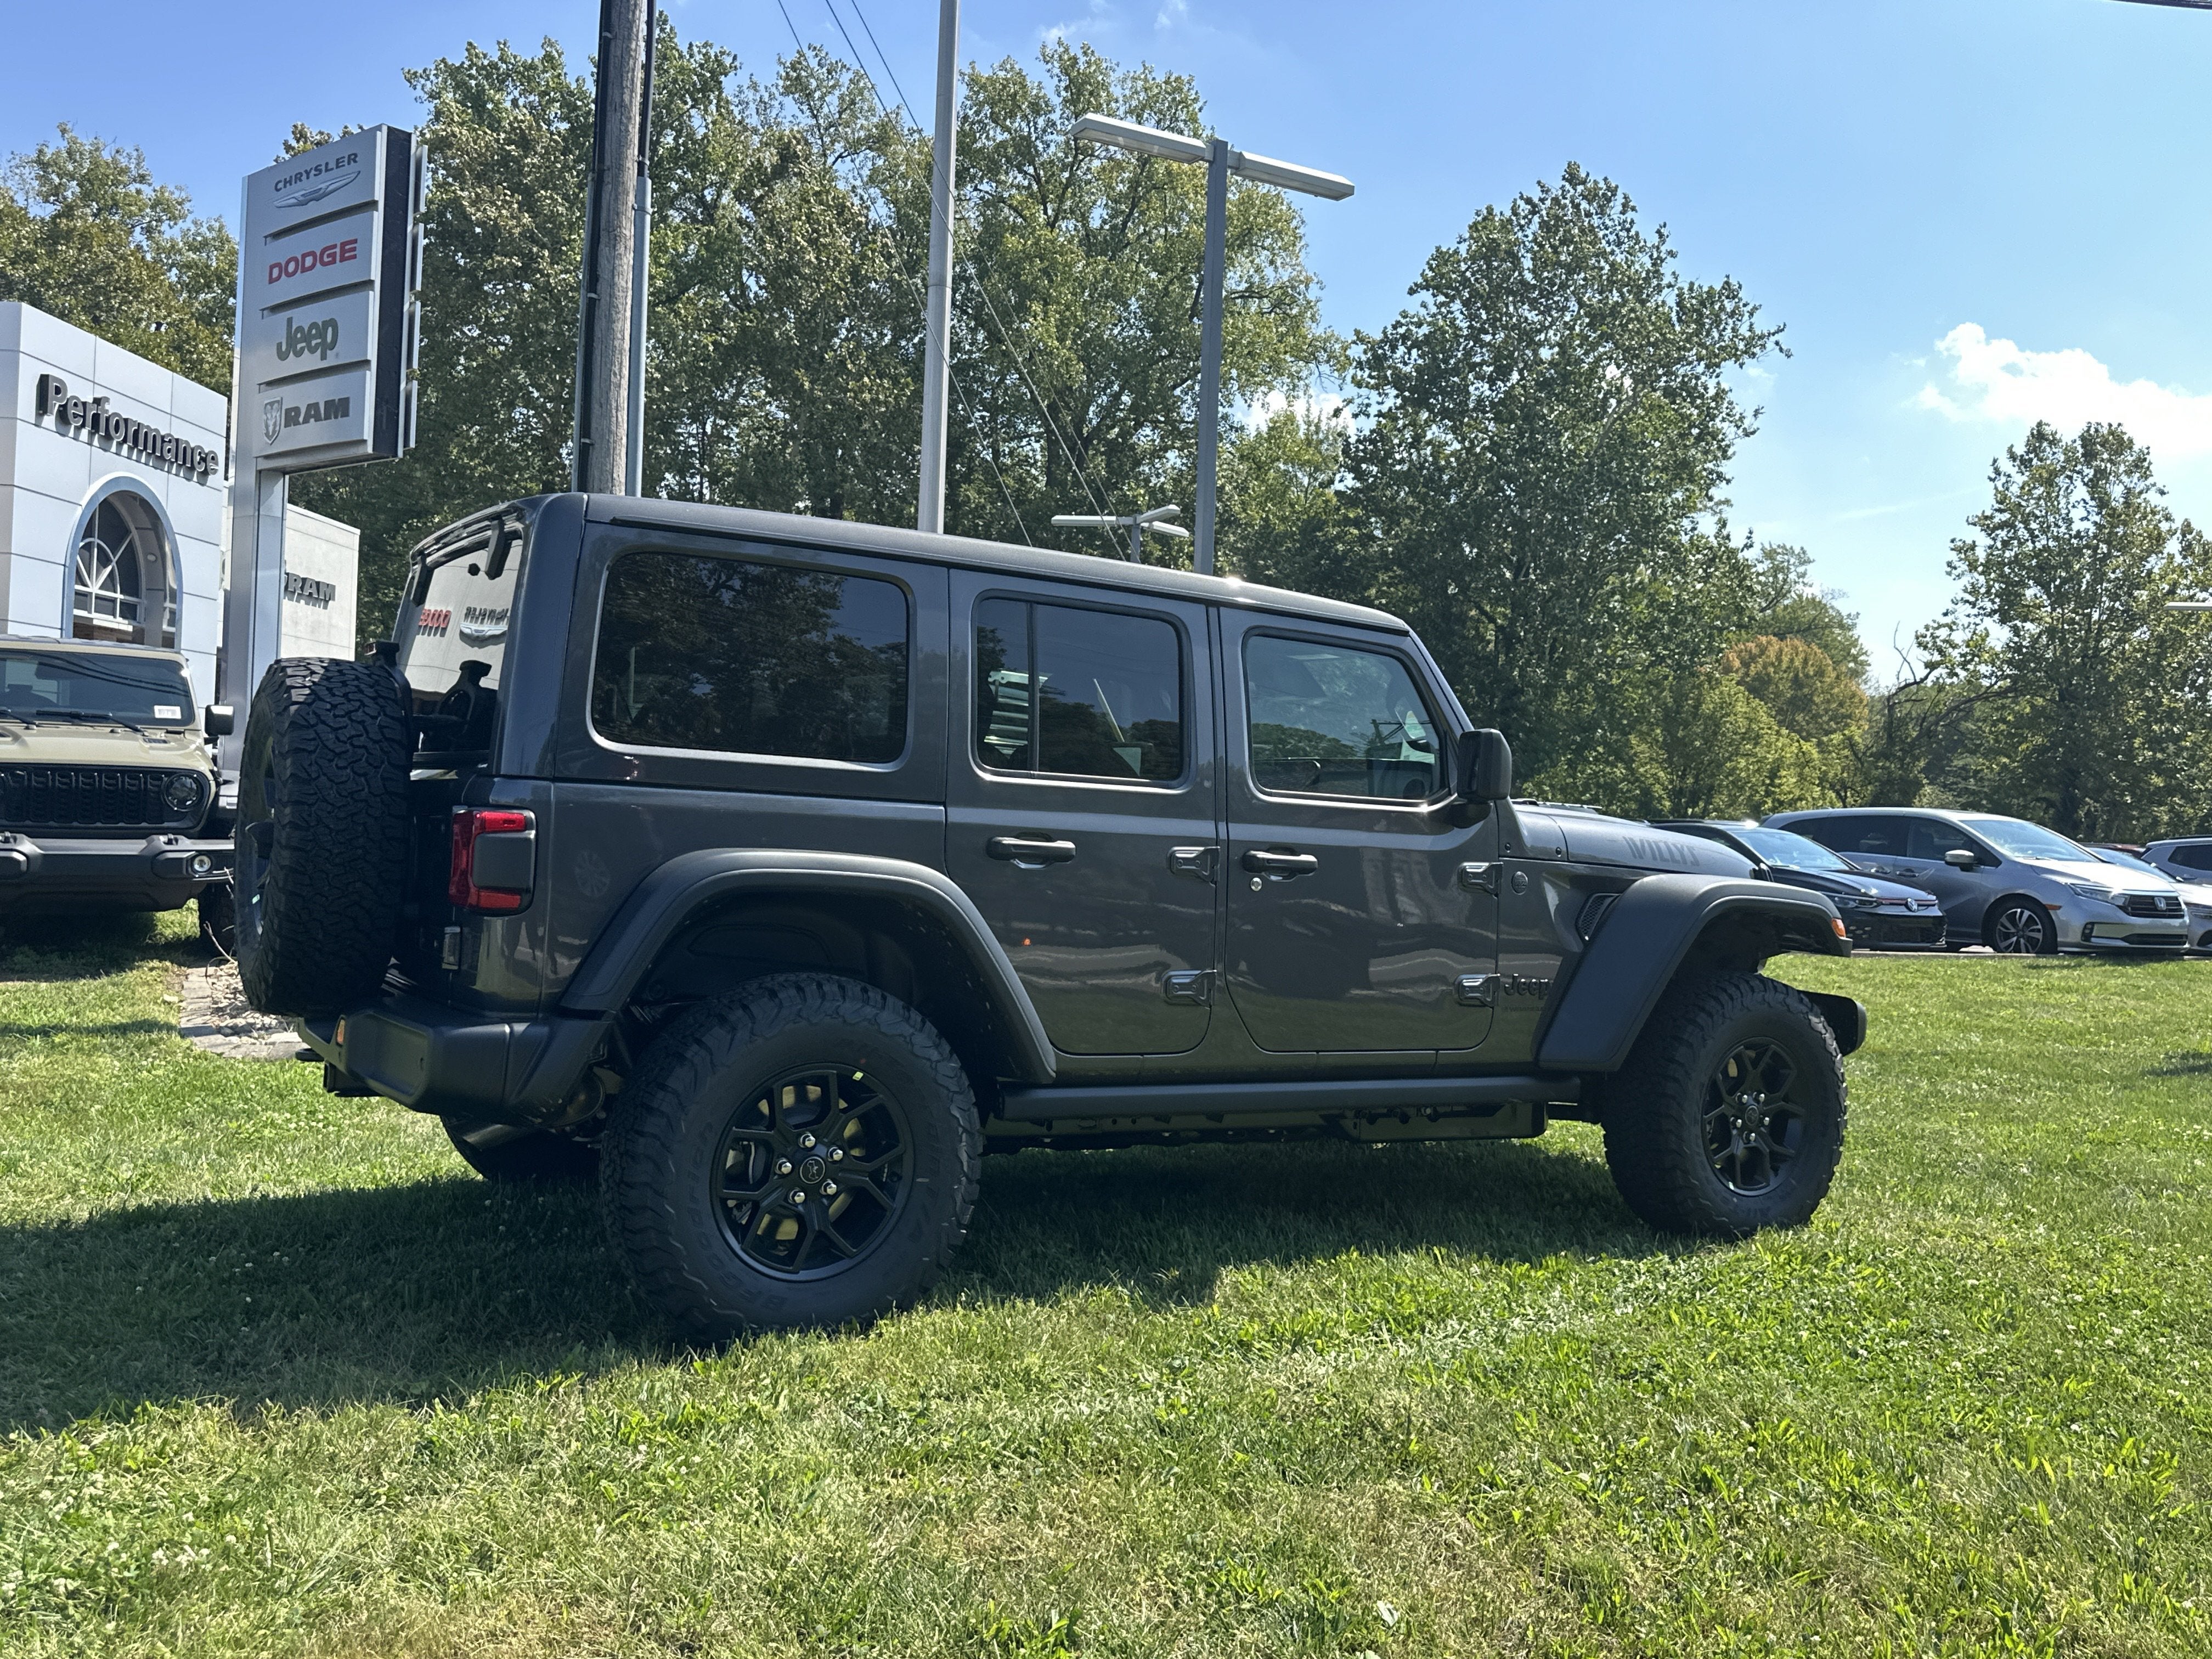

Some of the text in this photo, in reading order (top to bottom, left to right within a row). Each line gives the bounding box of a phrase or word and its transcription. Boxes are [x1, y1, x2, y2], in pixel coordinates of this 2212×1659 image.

[274, 153, 358, 192] CHRYSLER
[268, 238, 358, 285] DODGE
[276, 317, 338, 361] Jeep
[36, 374, 219, 475] Performance
[284, 397, 350, 428] RAM
[286, 572, 336, 601] RAM
[1622, 836, 1700, 867] WILLYS
[1504, 974, 1550, 1000] Jeep
